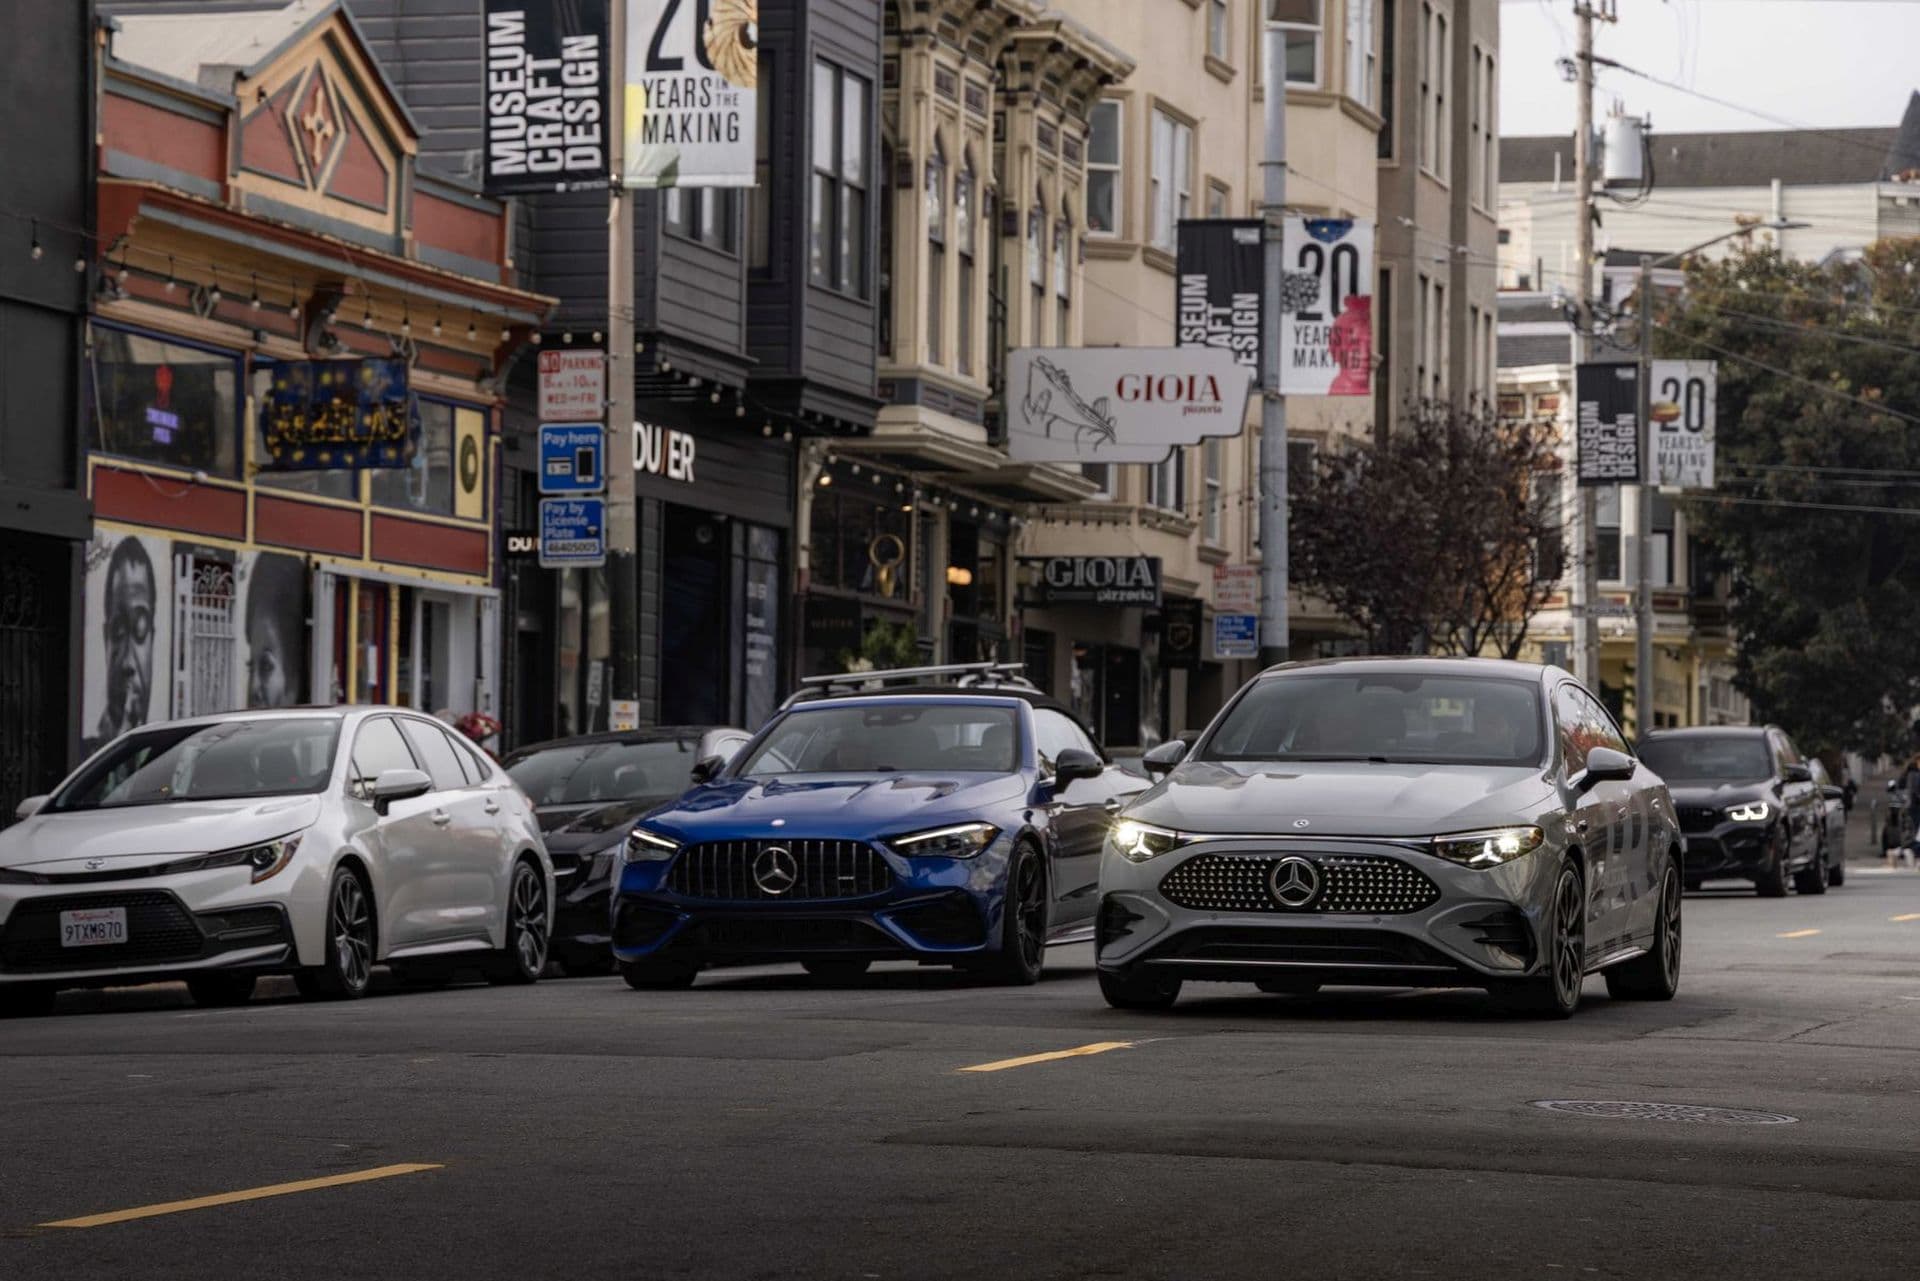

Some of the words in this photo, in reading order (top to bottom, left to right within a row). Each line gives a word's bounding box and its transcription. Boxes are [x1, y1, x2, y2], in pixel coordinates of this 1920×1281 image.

[489, 10, 526, 175] MUSEUM
[526, 53, 563, 174] CRAFT
[561, 34, 601, 171] DESIGN
[642, 77, 711, 109] YEARS
[641, 112, 739, 145] MAKING
[1296, 243, 1358, 321] 20
[1293, 324, 1342, 347] YEARS
[1292, 347, 1361, 370] MAKING
[1116, 375, 1222, 402] GIOIA
[1660, 377, 1706, 433] 20
[544, 432, 568, 447] Pay
[568, 431, 599, 444] here
[1579, 401, 1600, 478] MUSEUM
[1600, 423, 1617, 478] CRAFT
[1616, 413, 1636, 477] DESIGN
[1046, 558, 1154, 587] GIOIA
[65, 921, 122, 942] 9TXM870
